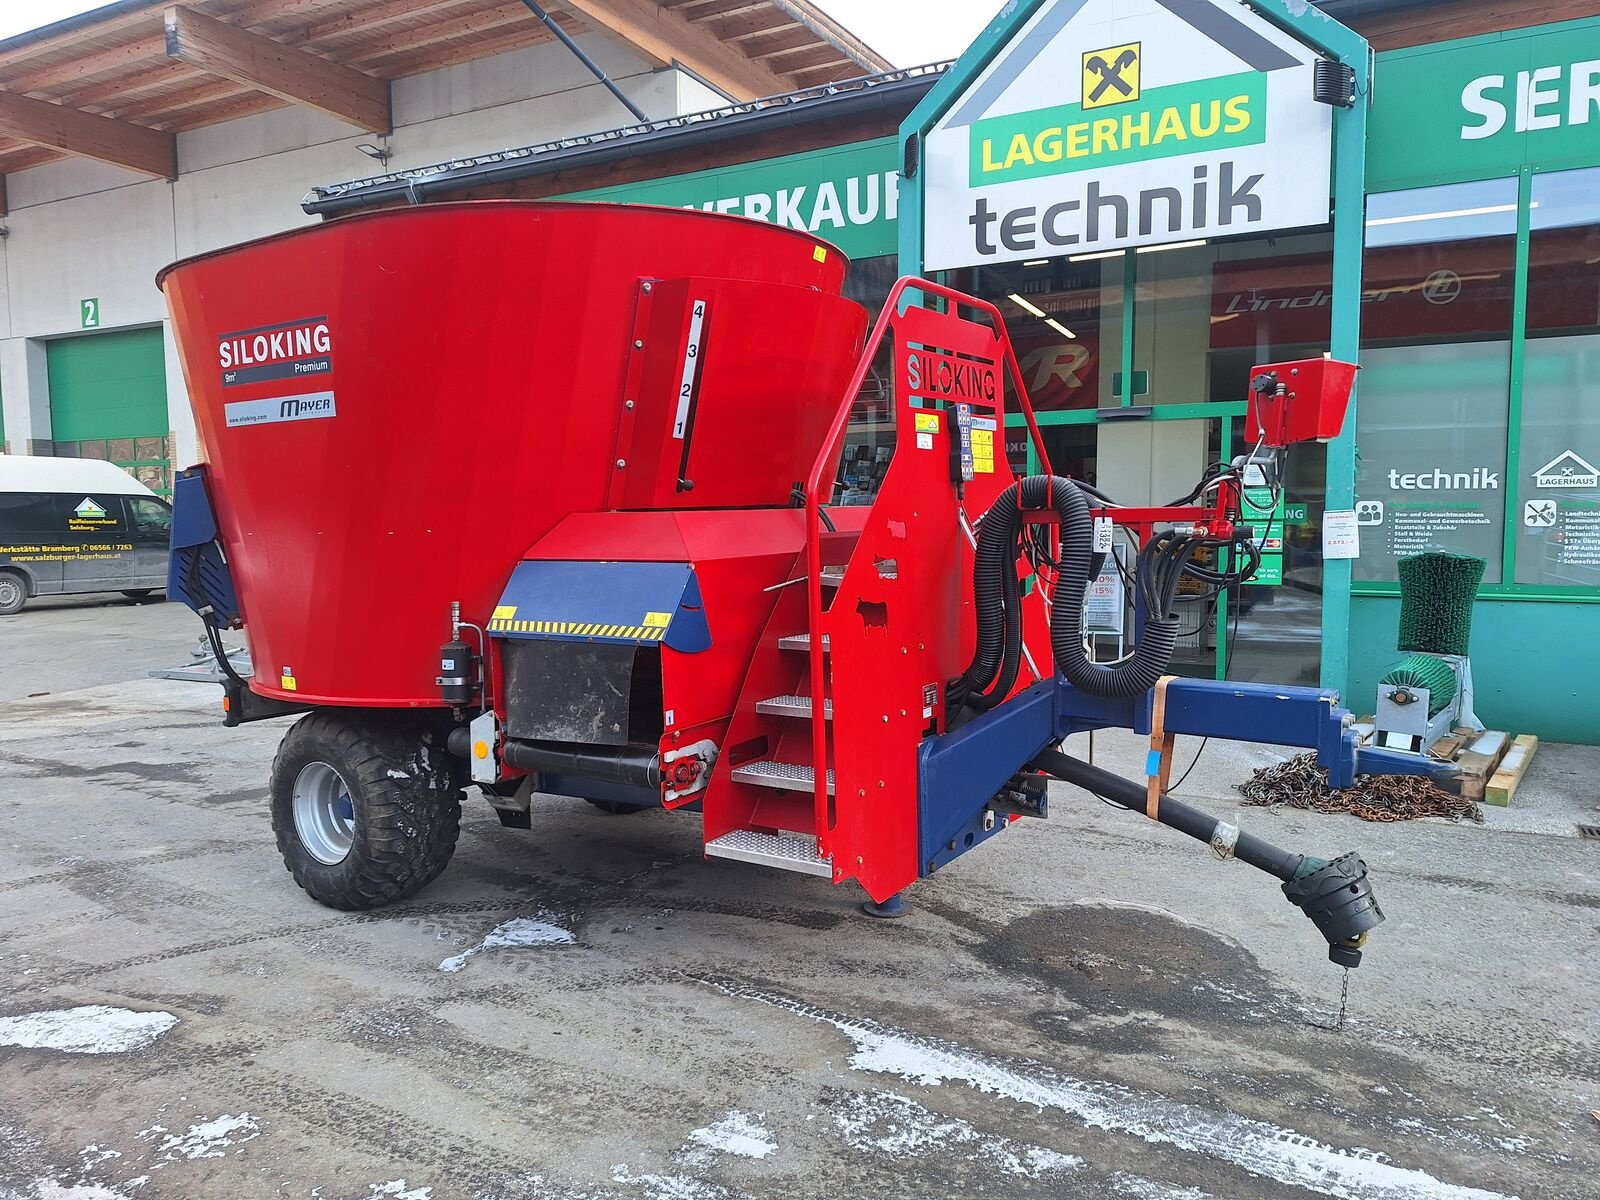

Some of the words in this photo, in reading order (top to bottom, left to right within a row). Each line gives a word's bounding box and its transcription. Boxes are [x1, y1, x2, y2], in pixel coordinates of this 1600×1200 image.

[1461, 59, 1600, 140] SER
[982, 94, 1251, 173] LAGERHAUS
[683, 170, 900, 232] RKAUF
[968, 160, 1265, 256] technik
[84, 300, 96, 326] 2
[694, 305, 703, 319] 4
[219, 324, 331, 368] SILOKING
[688, 344, 697, 358] 3
[294, 361, 328, 373] Premium
[907, 353, 996, 402] SILOKING
[681, 383, 691, 397] 2
[229, 415, 268, 423] www.siloking.com
[280, 399, 330, 417] MAYER
[677, 421, 683, 435] 1
[1388, 467, 1499, 490] technik
[11, 553, 121, 562] www.salzburger-lagerhaus.at
[42, 545, 80, 553] Bramberg
